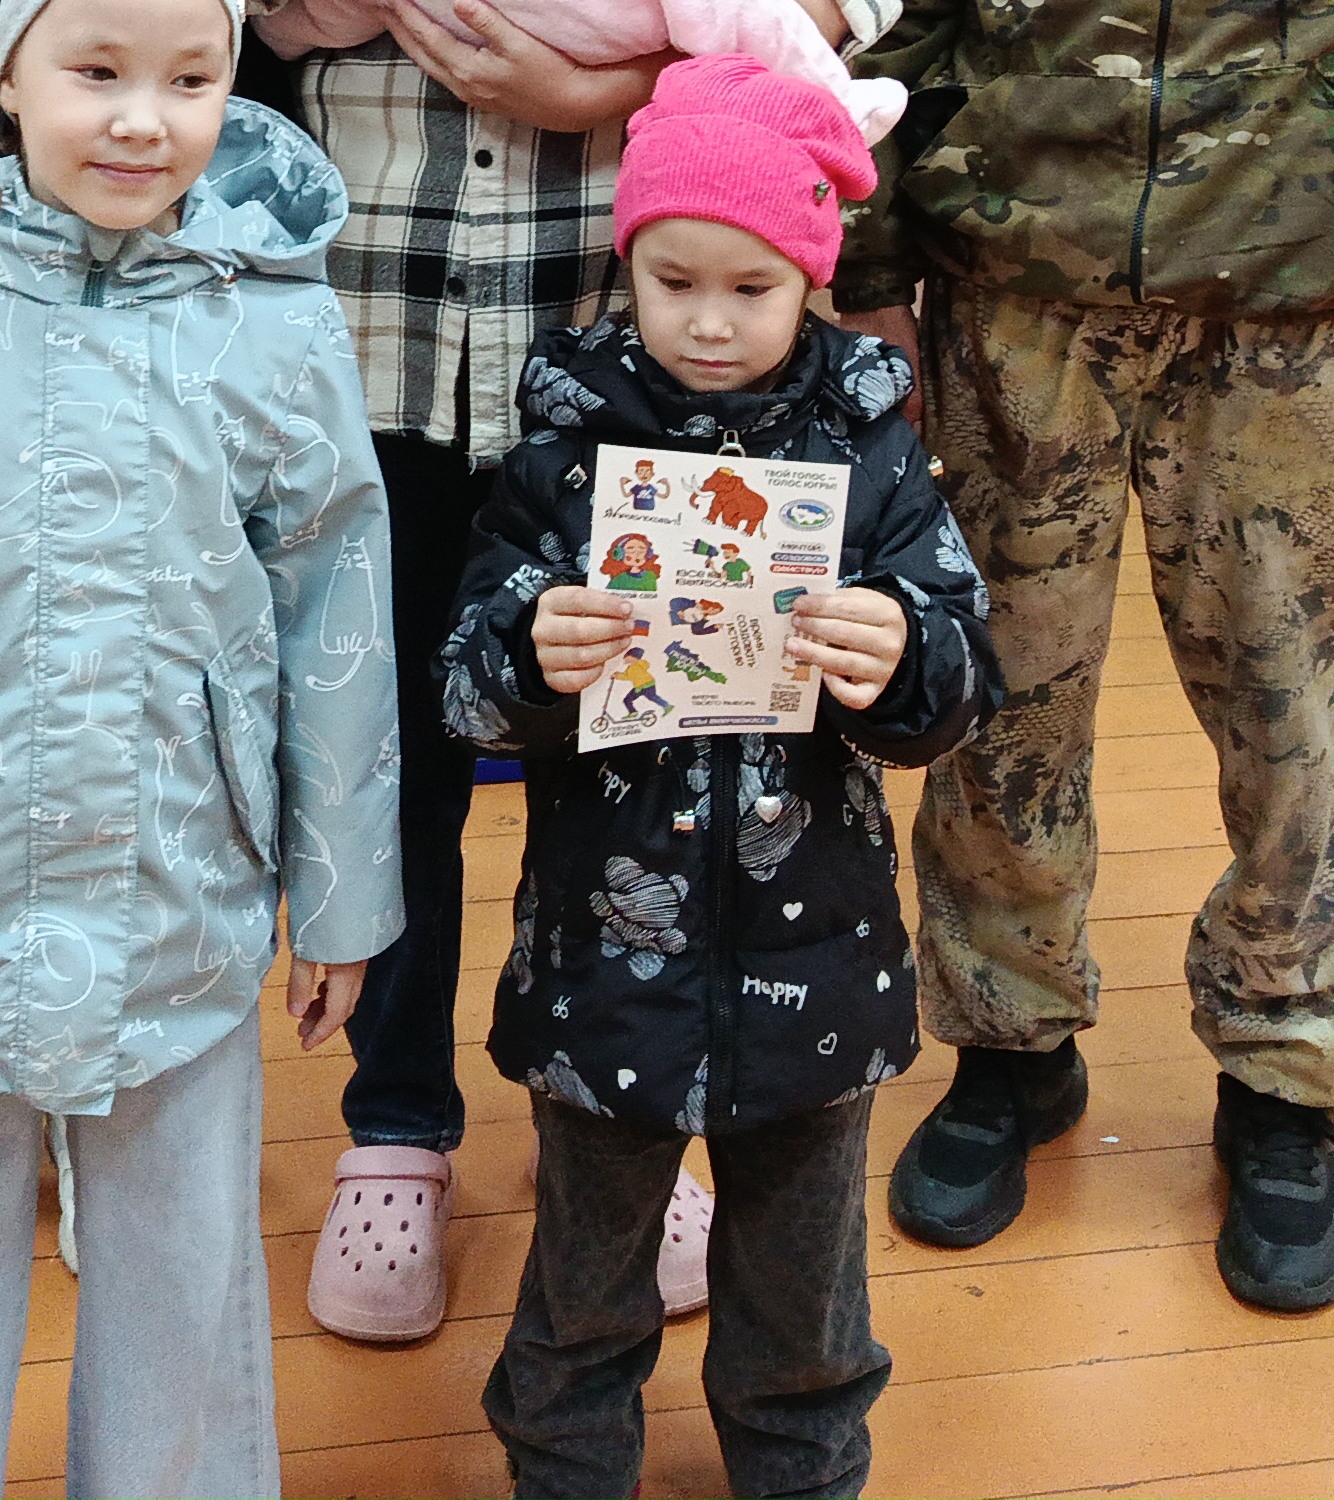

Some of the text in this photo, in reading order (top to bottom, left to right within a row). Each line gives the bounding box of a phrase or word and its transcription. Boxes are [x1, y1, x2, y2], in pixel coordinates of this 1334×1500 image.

[767, 478, 802, 489] ГОЛОС
[792, 471, 827, 481] ГОЛОС
[726, 622, 744, 667] ИСТОРИЮ
[741, 976, 809, 1011] Happy
